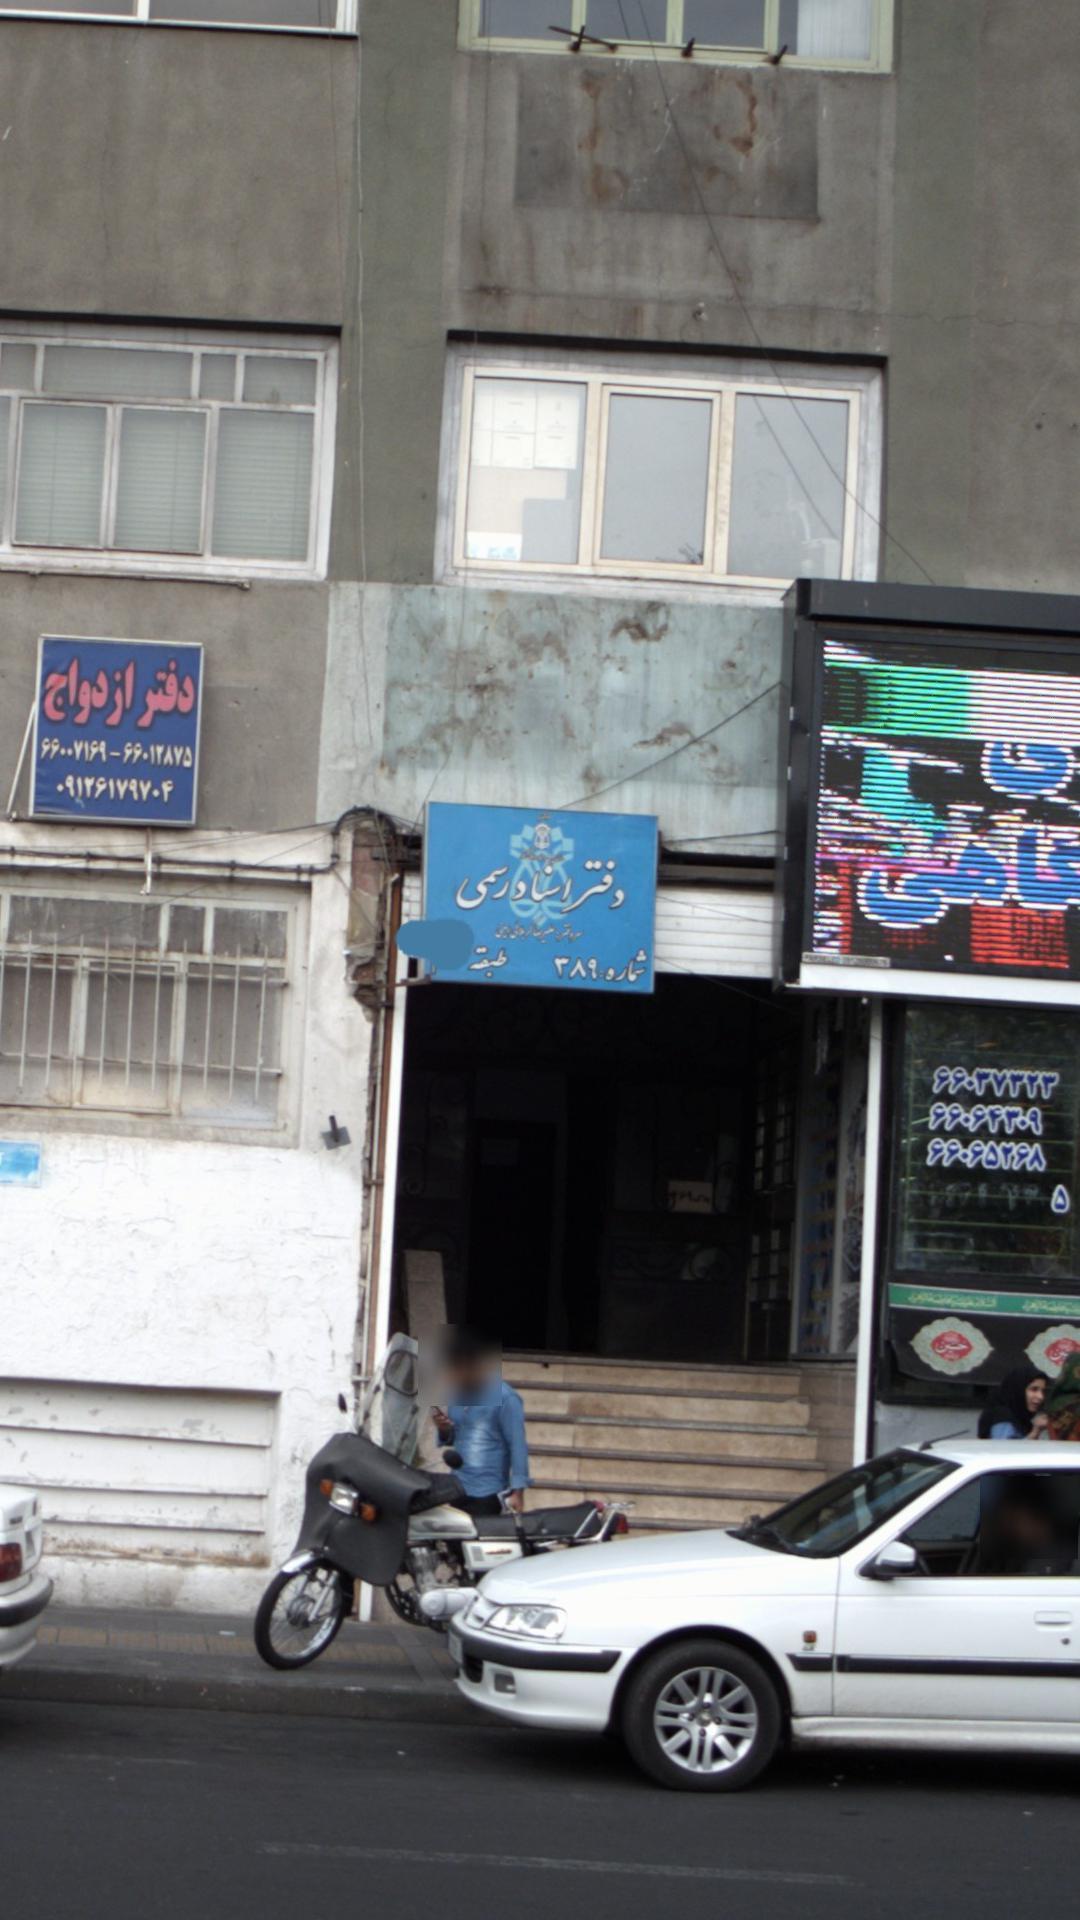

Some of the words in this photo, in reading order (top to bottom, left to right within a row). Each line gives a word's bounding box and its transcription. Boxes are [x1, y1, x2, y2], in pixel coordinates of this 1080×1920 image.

[44, 657, 135, 725] ازدواج
[137, 659, 196, 728] دفتر
[455, 865, 510, 910] رسمی
[511, 866, 572, 903] اسناد
[560, 859, 625, 914] دفتر
[469, 946, 508, 978] طبقه
[554, 955, 598, 980] ۳۸۹
[928, 1102, 1044, 1136] ۶۶۰۶۴۳۰۹
[926, 1137, 1047, 1172] ۶۶۰۶۵۲۶۸
